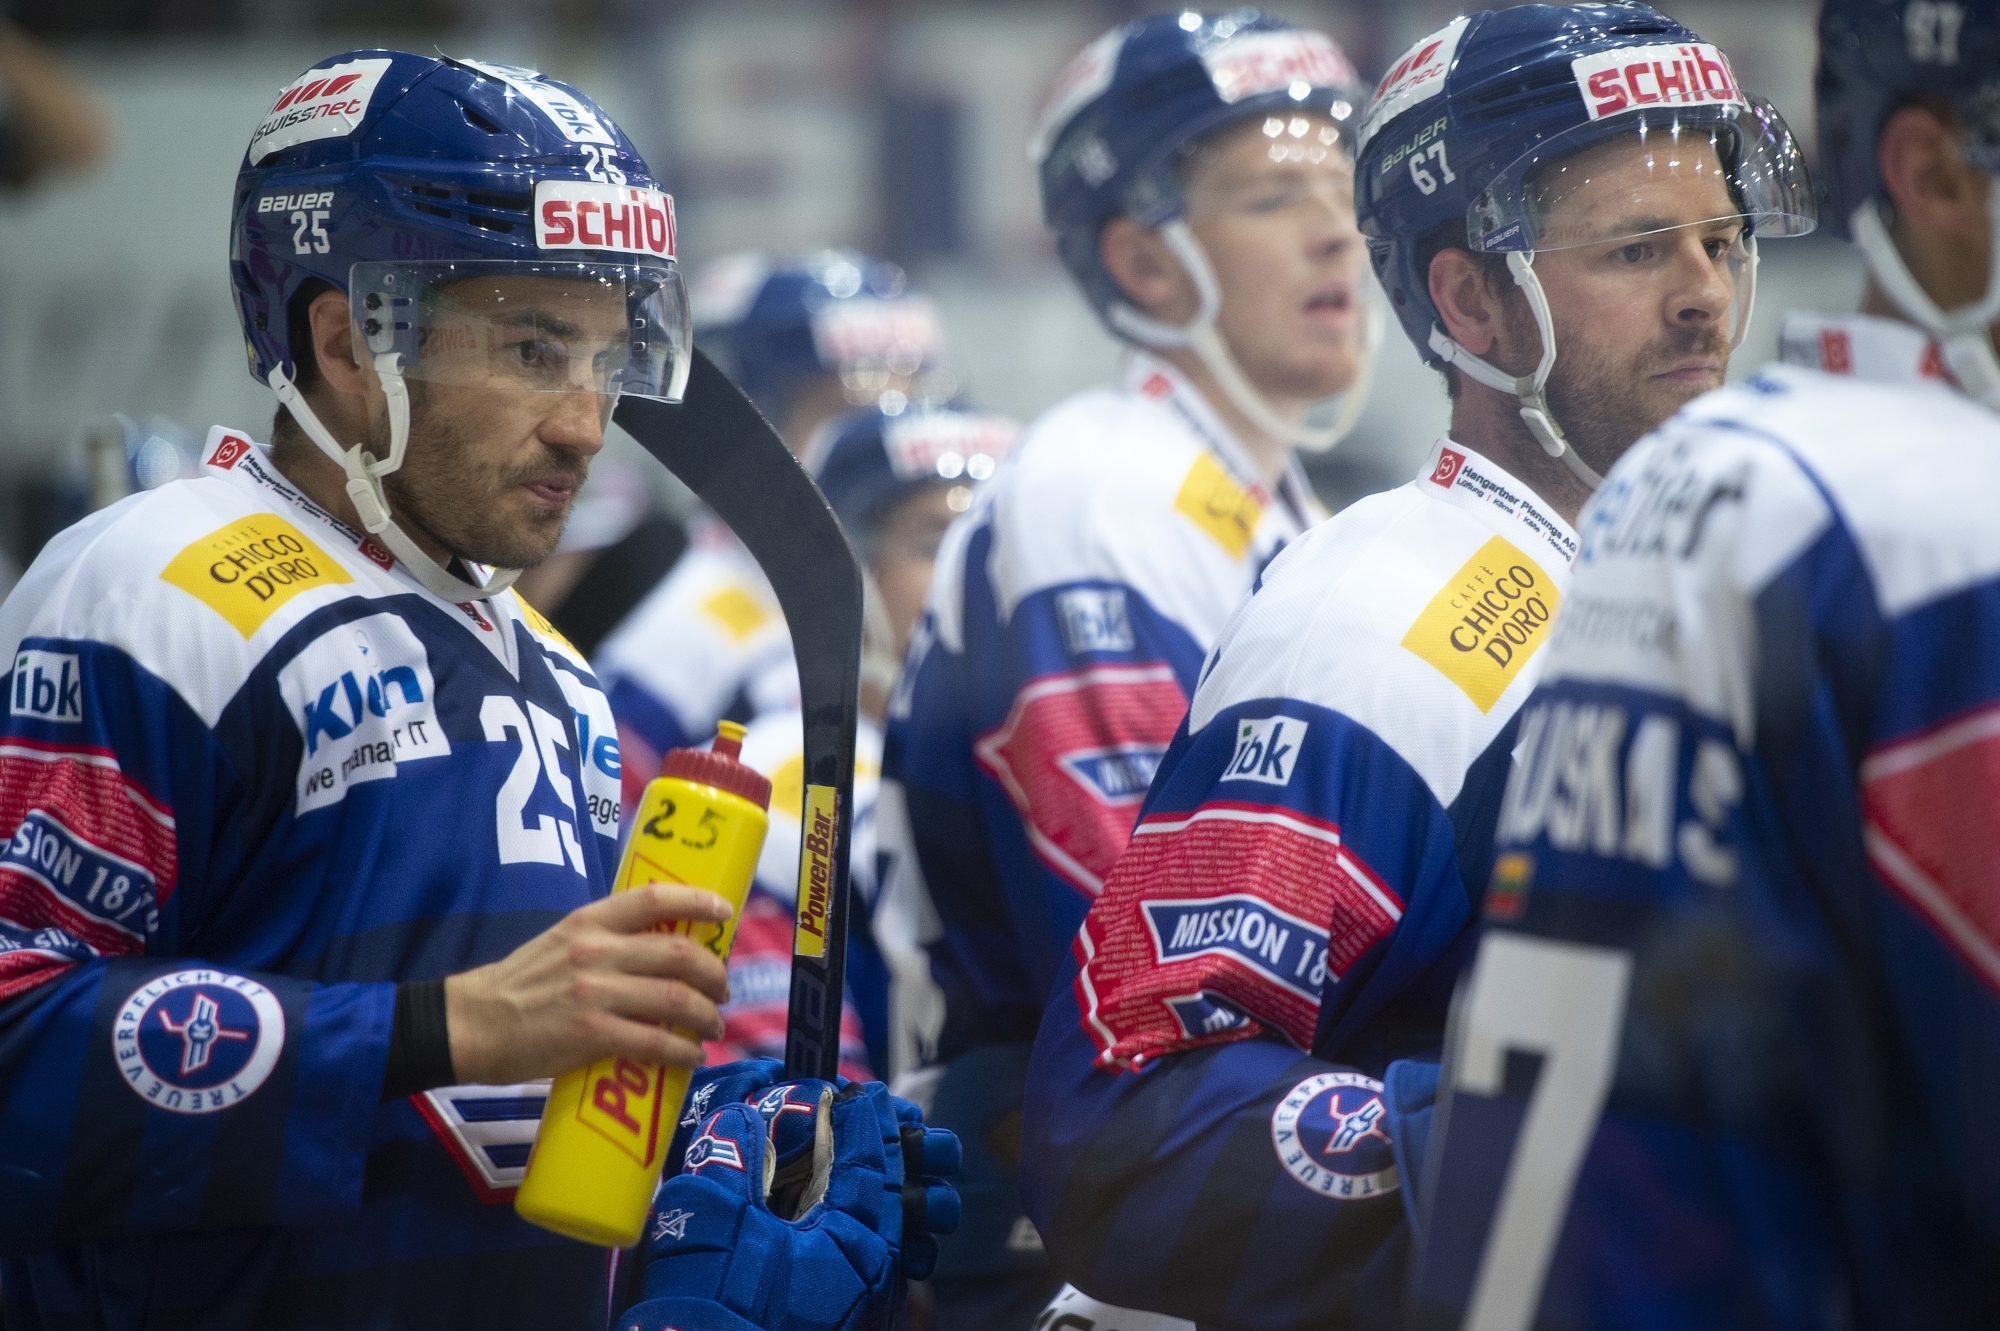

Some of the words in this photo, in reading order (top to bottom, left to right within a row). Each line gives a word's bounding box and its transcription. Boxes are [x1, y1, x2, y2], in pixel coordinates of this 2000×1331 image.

[254, 99, 362, 144] swissnet
[580, 144, 627, 185] 25
[1408, 139, 1456, 196] 67
[290, 210, 331, 255] 25
[1461, 465, 1521, 505] Hangartner
[1520, 501, 1562, 539] Planungs
[209, 532, 304, 585] CHICCO
[1450, 565, 1535, 653] CHICCO
[16, 656, 81, 717] ibk
[1226, 722, 1292, 779] ibk
[478, 695, 588, 878] 25
[643, 798, 727, 850] 25
[800, 806, 831, 938] PowerBar
[1168, 907, 1289, 965] MISSION
[147, 1080, 247, 1110] TREUE
